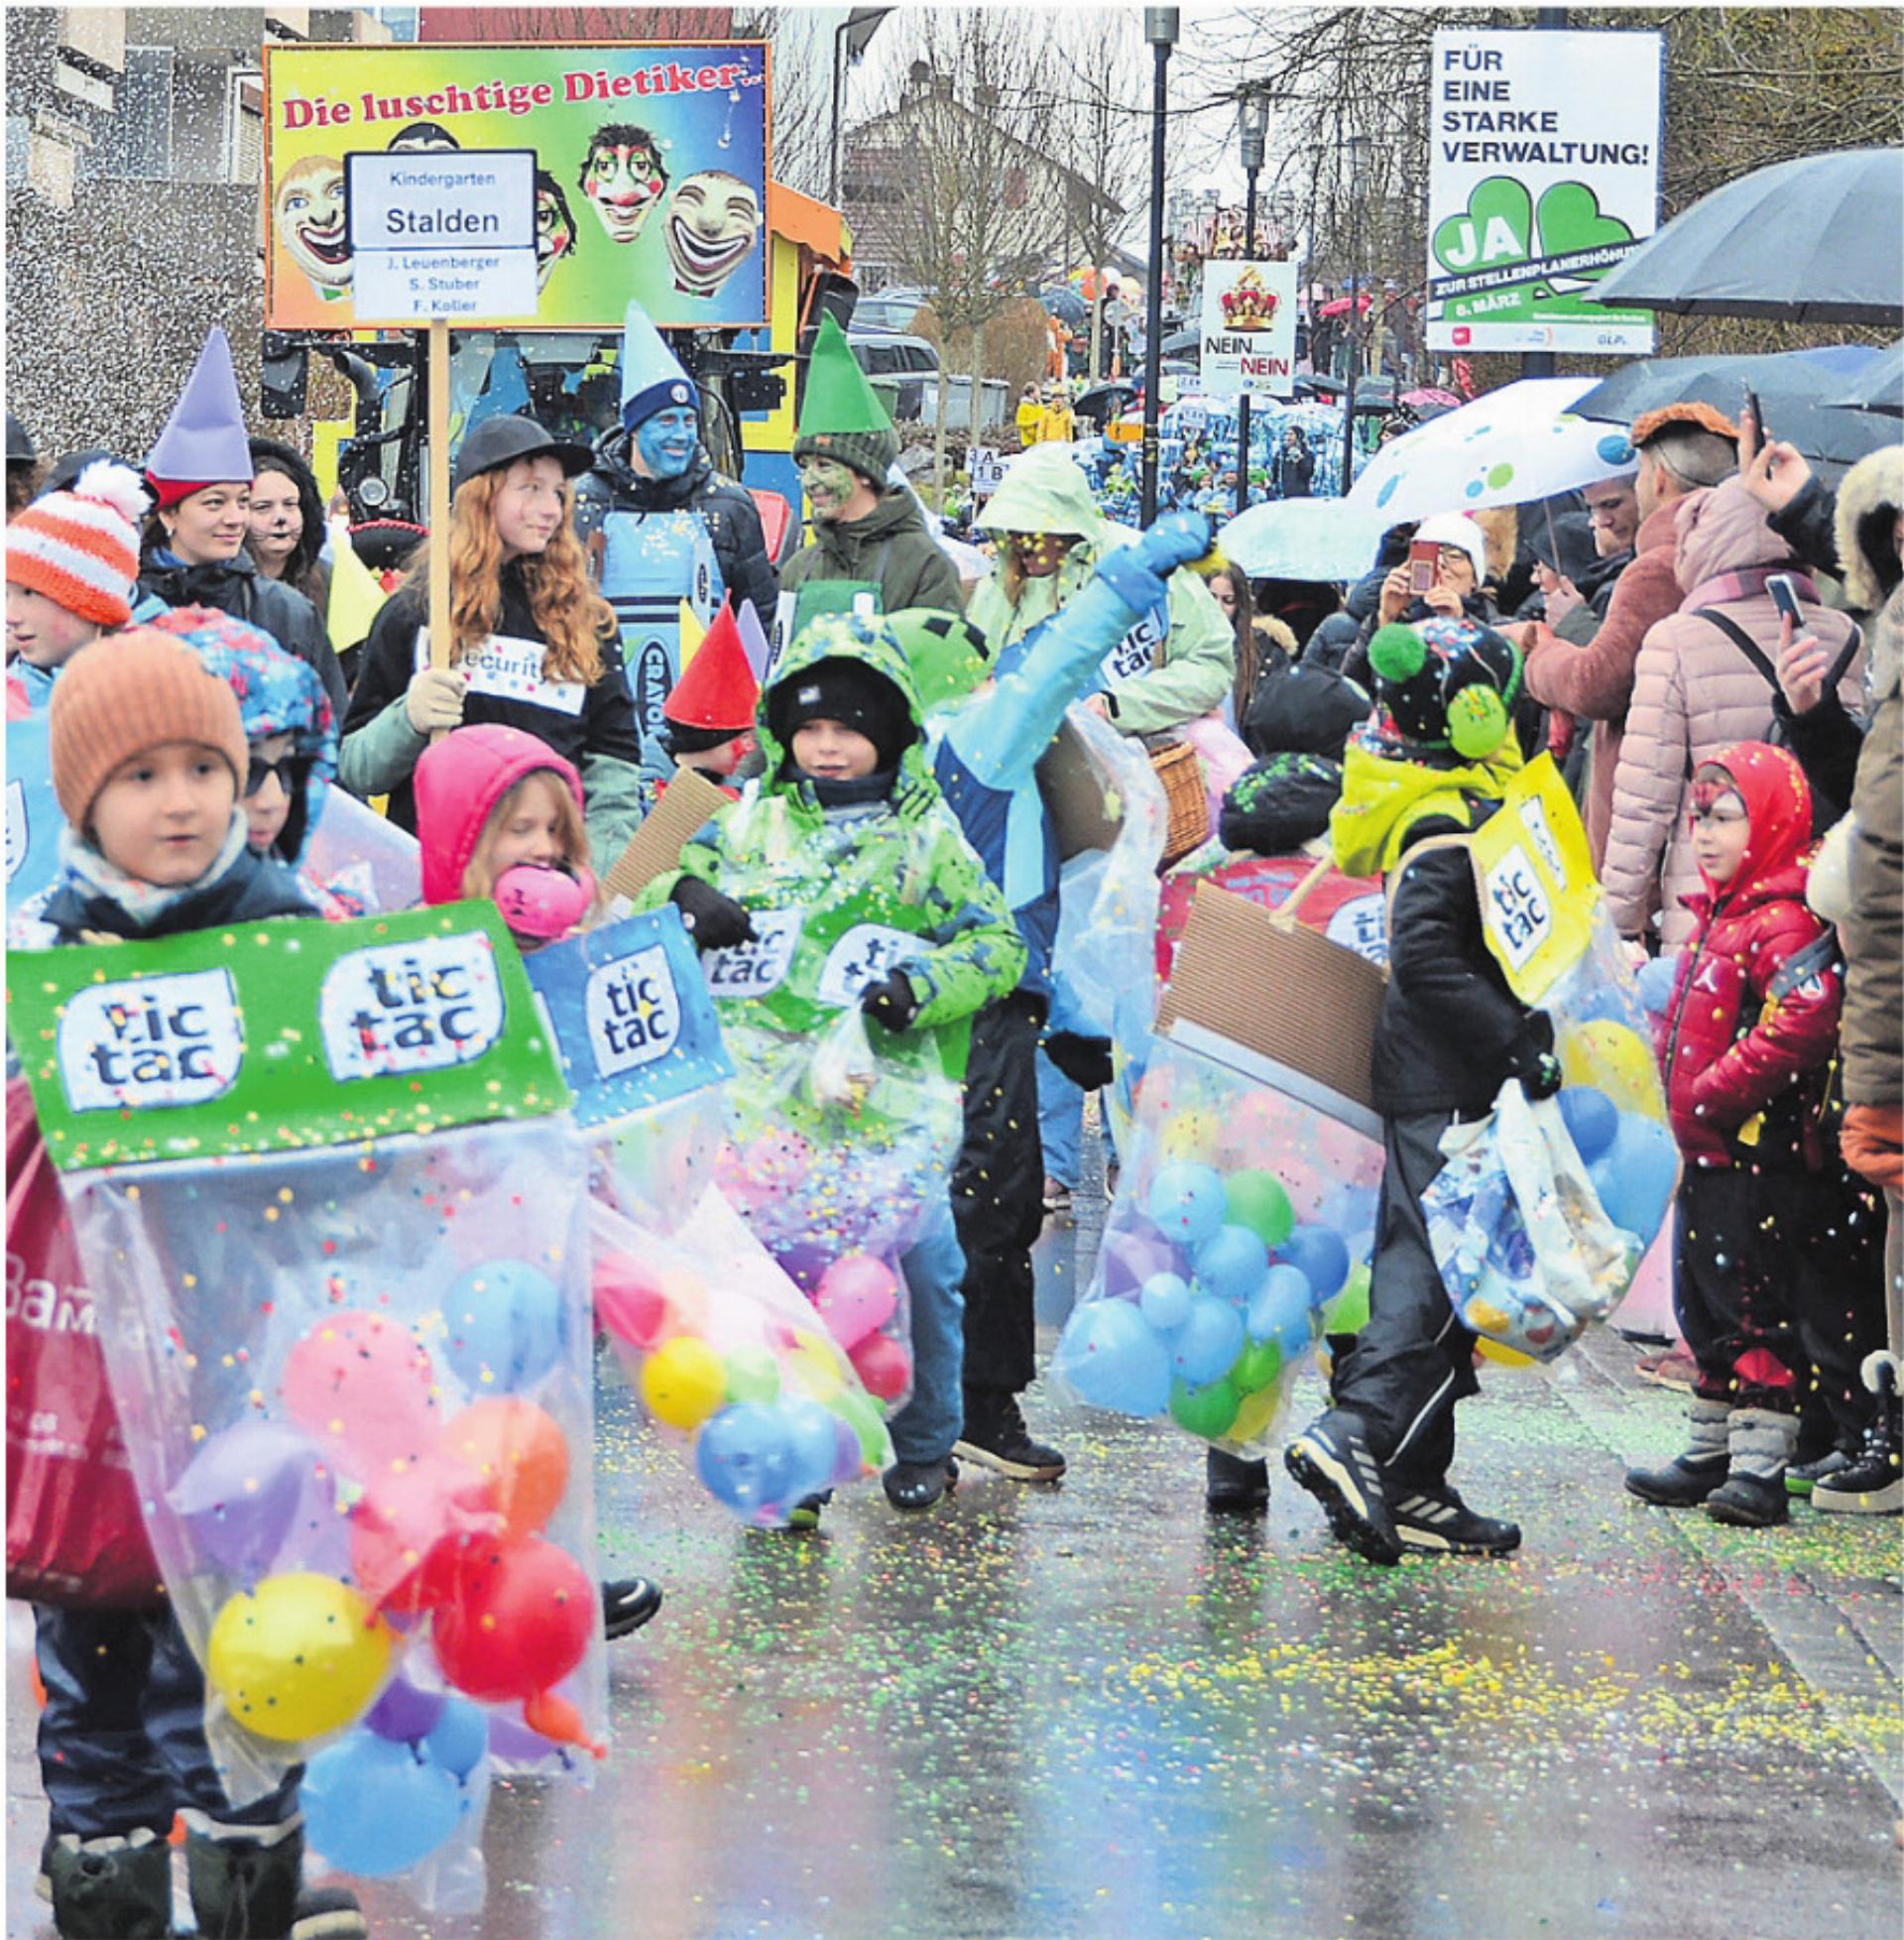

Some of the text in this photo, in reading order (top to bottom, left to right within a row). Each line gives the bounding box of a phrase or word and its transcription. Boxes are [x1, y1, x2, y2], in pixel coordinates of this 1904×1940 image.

[1444, 45, 1502, 70] FÜR
[1444, 80, 1511, 101] EINE
[282, 97, 352, 130] Die
[362, 79, 552, 122] luschtige
[1443, 111, 1559, 132] STARKE
[1443, 141, 1649, 166] VERWALTUNG!
[390, 172, 496, 189] Kindergarten
[387, 208, 499, 234] Stalden
[1445, 216, 1523, 267] JA
[388, 256, 500, 271] J. Leuenberger
[410, 277, 480, 291] S. Stuber
[1435, 279, 1467, 296] ZUR
[414, 299, 477, 312] F. Koller
[1473, 292, 1522, 314] MÄRZ
[1205, 337, 1252, 355] NEIN
[1241, 357, 1289, 377] NEIN
[464, 650, 546, 684] ecurit
[1492, 871, 1531, 915] tic
[1502, 898, 1545, 950] tac
[711, 953, 775, 984] tac
[368, 958, 470, 1008] tic
[607, 975, 659, 1017] tic
[349, 1006, 480, 1052] tac
[604, 1010, 668, 1054] tac
[90, 1044, 215, 1085] tac
